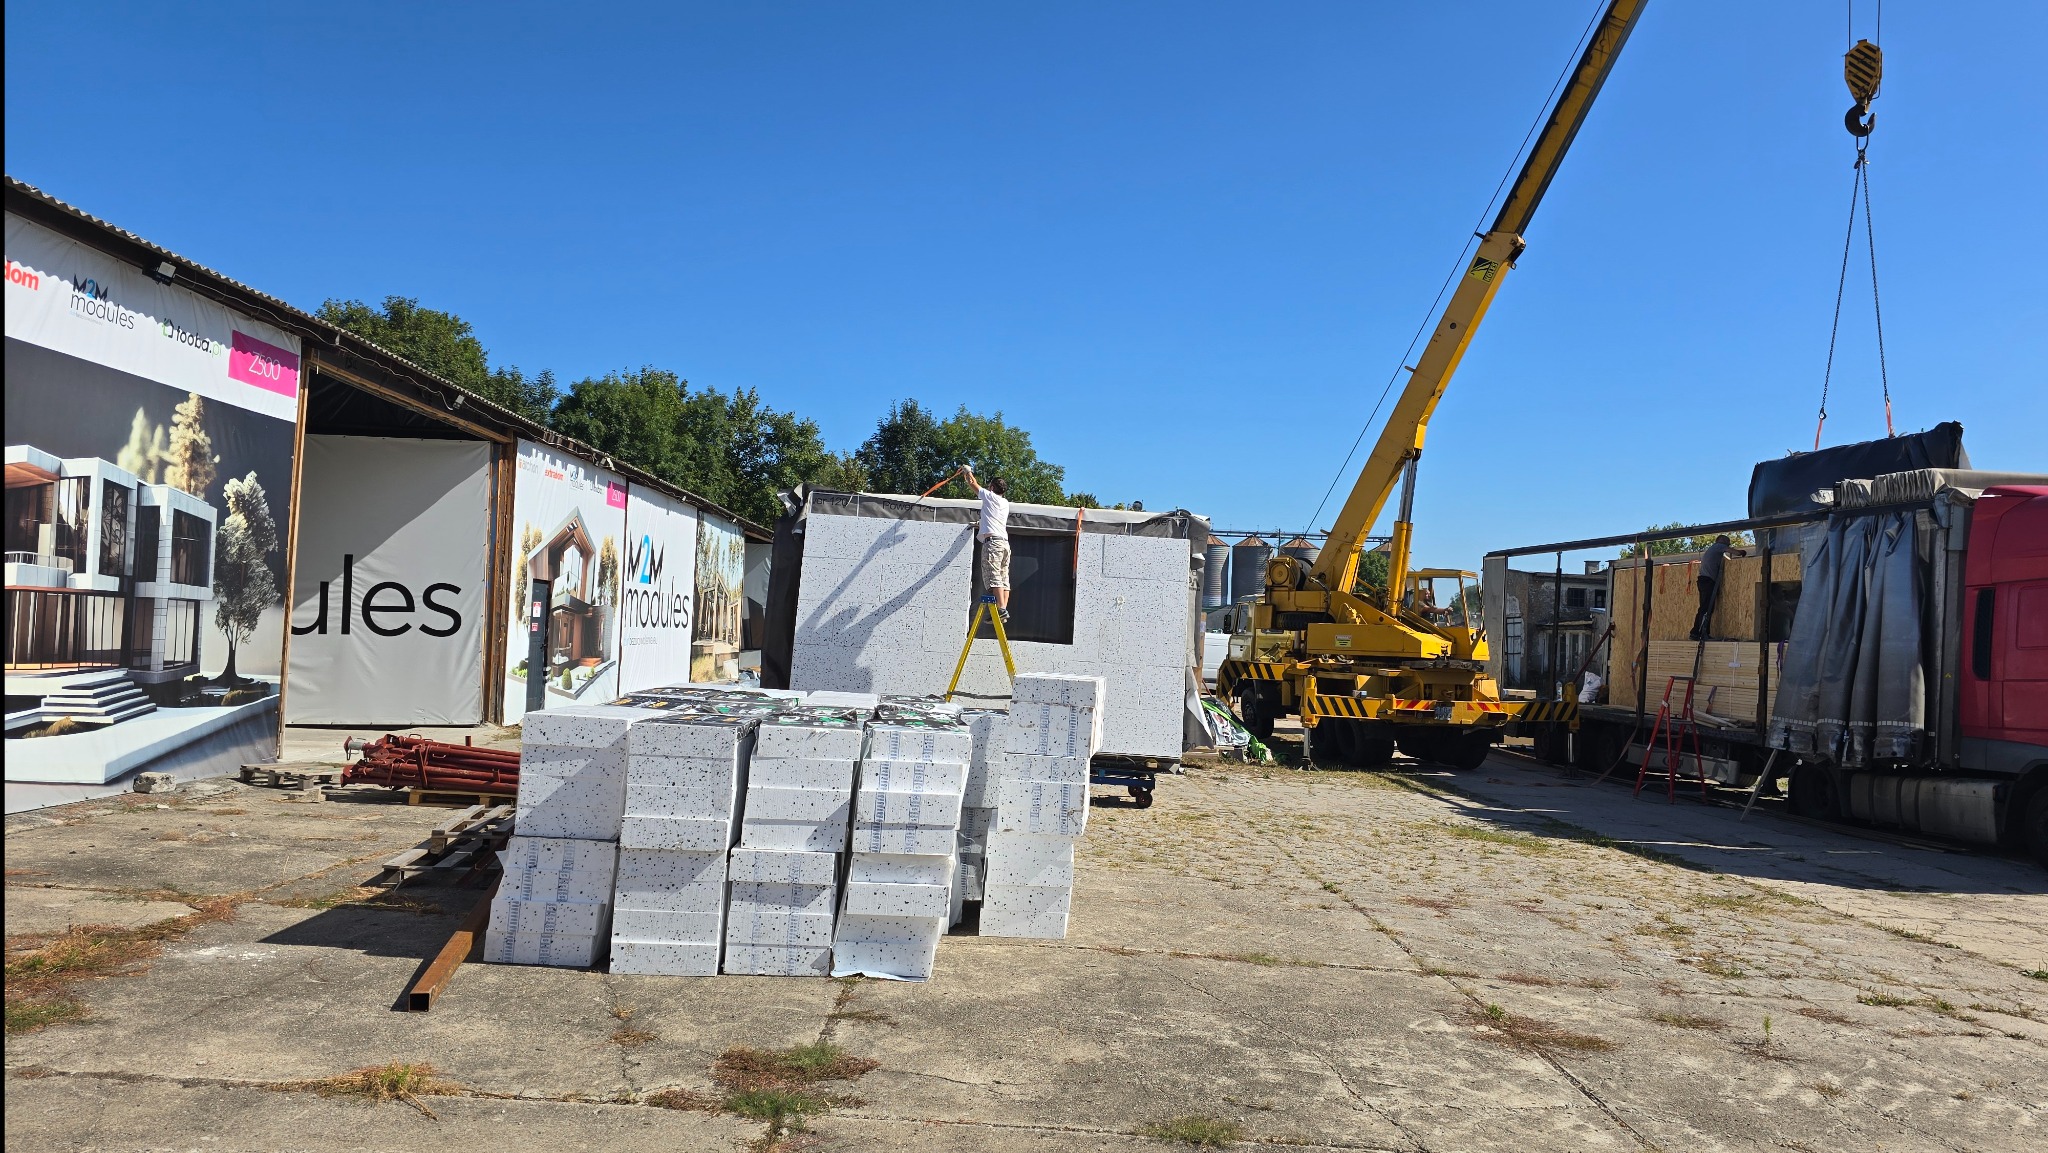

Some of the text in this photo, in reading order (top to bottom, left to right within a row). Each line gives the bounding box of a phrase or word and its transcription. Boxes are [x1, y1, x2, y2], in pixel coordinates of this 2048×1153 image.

[73, 273, 108, 301] M2M
[70, 293, 135, 330] modules
[882, 500, 915, 511] Power
[626, 530, 664, 585] M2M
[291, 554, 463, 638] ules
[624, 575, 690, 629] modules
